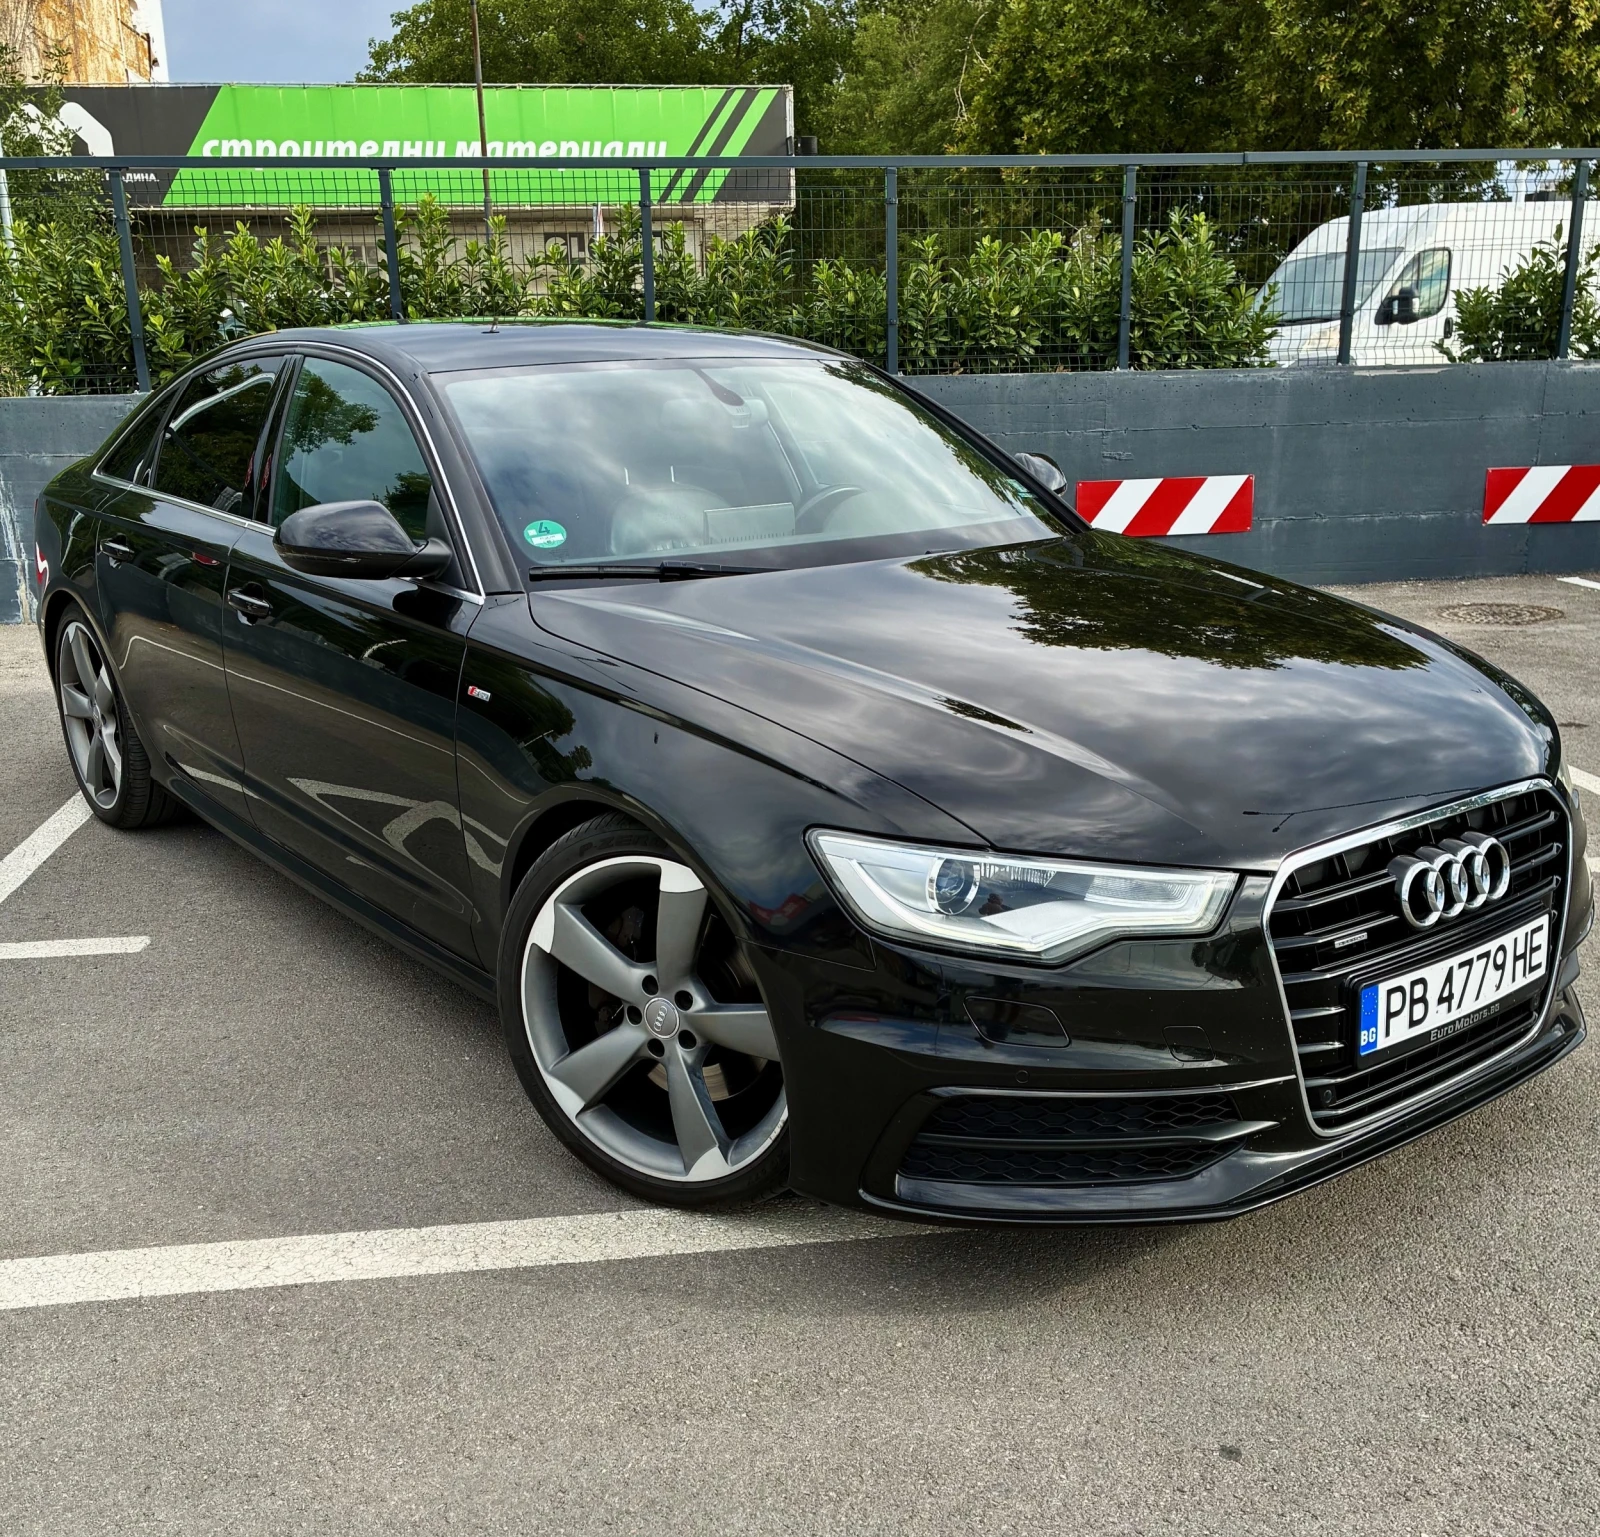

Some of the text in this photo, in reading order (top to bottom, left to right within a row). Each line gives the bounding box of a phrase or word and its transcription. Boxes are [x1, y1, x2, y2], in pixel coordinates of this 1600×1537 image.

[1385, 923, 1545, 1039] PB 4779 HE
[1360, 1030, 1377, 1047] BG
